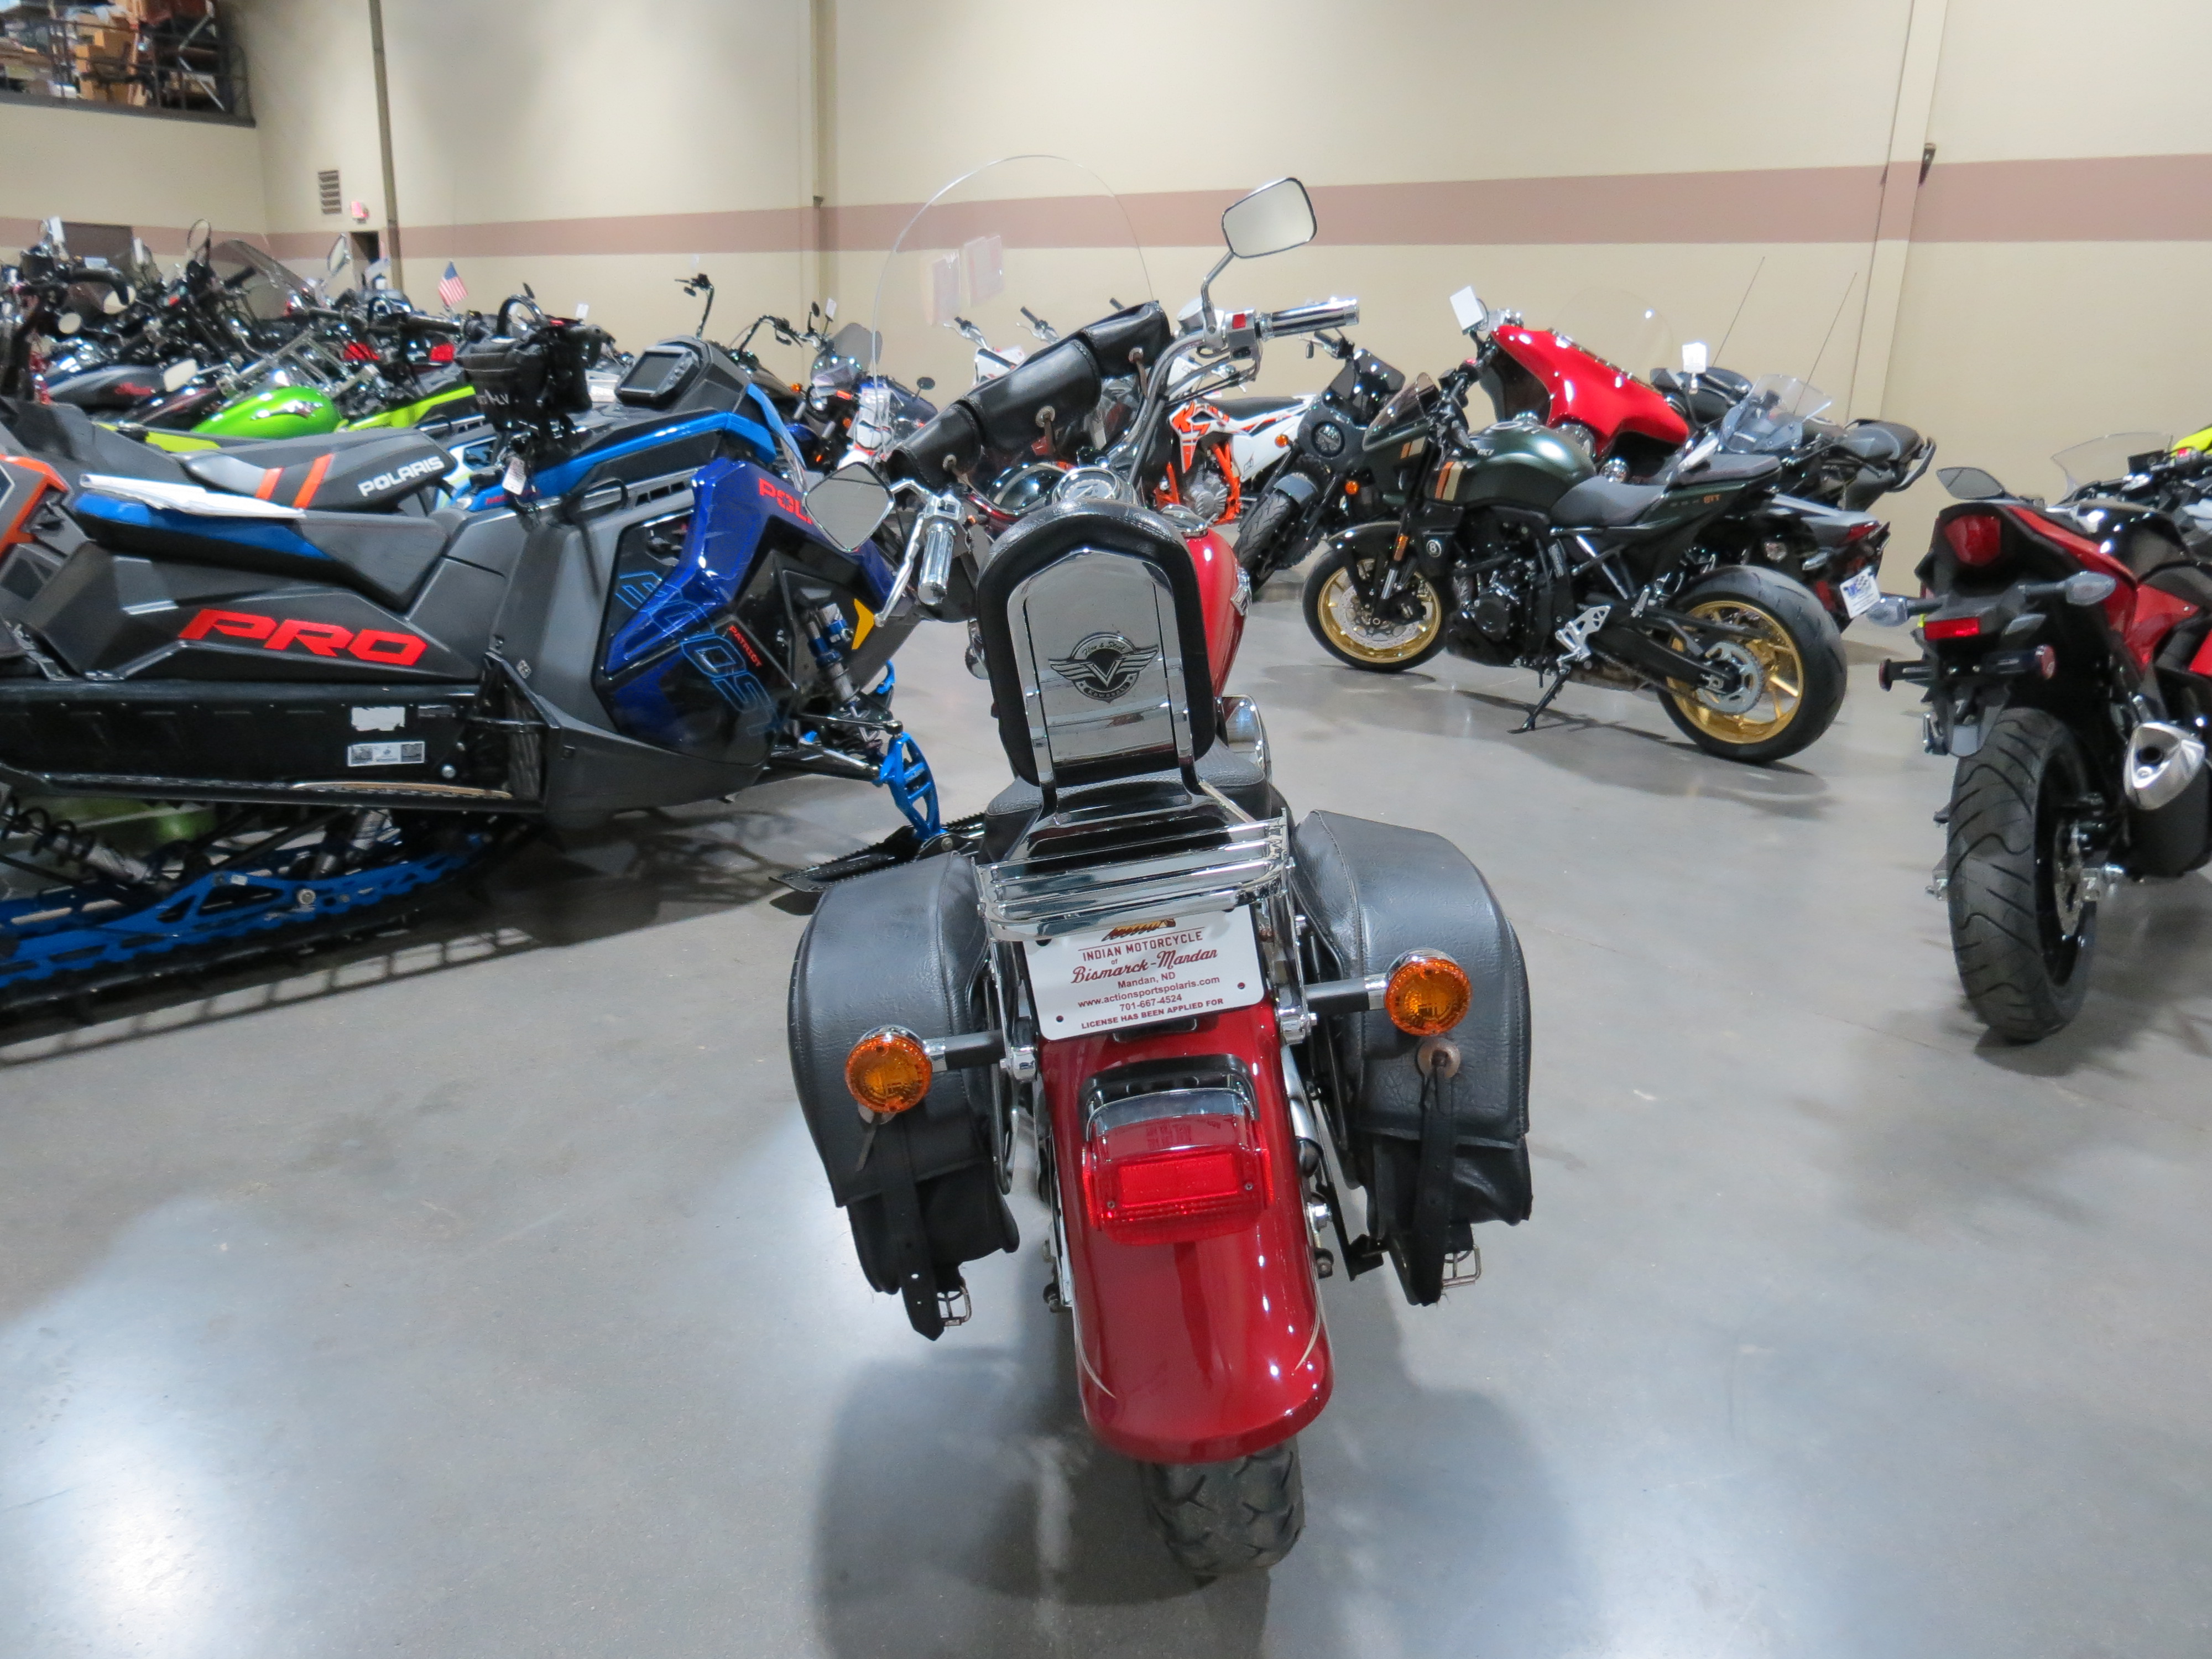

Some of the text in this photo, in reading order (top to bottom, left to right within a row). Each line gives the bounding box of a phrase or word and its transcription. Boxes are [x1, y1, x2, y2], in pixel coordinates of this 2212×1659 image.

[358, 456, 445, 497] POLARIS
[759, 478, 813, 525] POL
[178, 608, 428, 666] PRO
[1082, 931, 1203, 962] INDIAN MOTORCYCLE
[1077, 977, 1220, 1008] www.actionsportspolaris.com
[1117, 971, 1176, 989] Mandan, ND
[1081, 998, 1224, 1029] LICENSE HAS BEEN APPLIED FOR
[1119, 993, 1182, 1012] 701-667-4524
